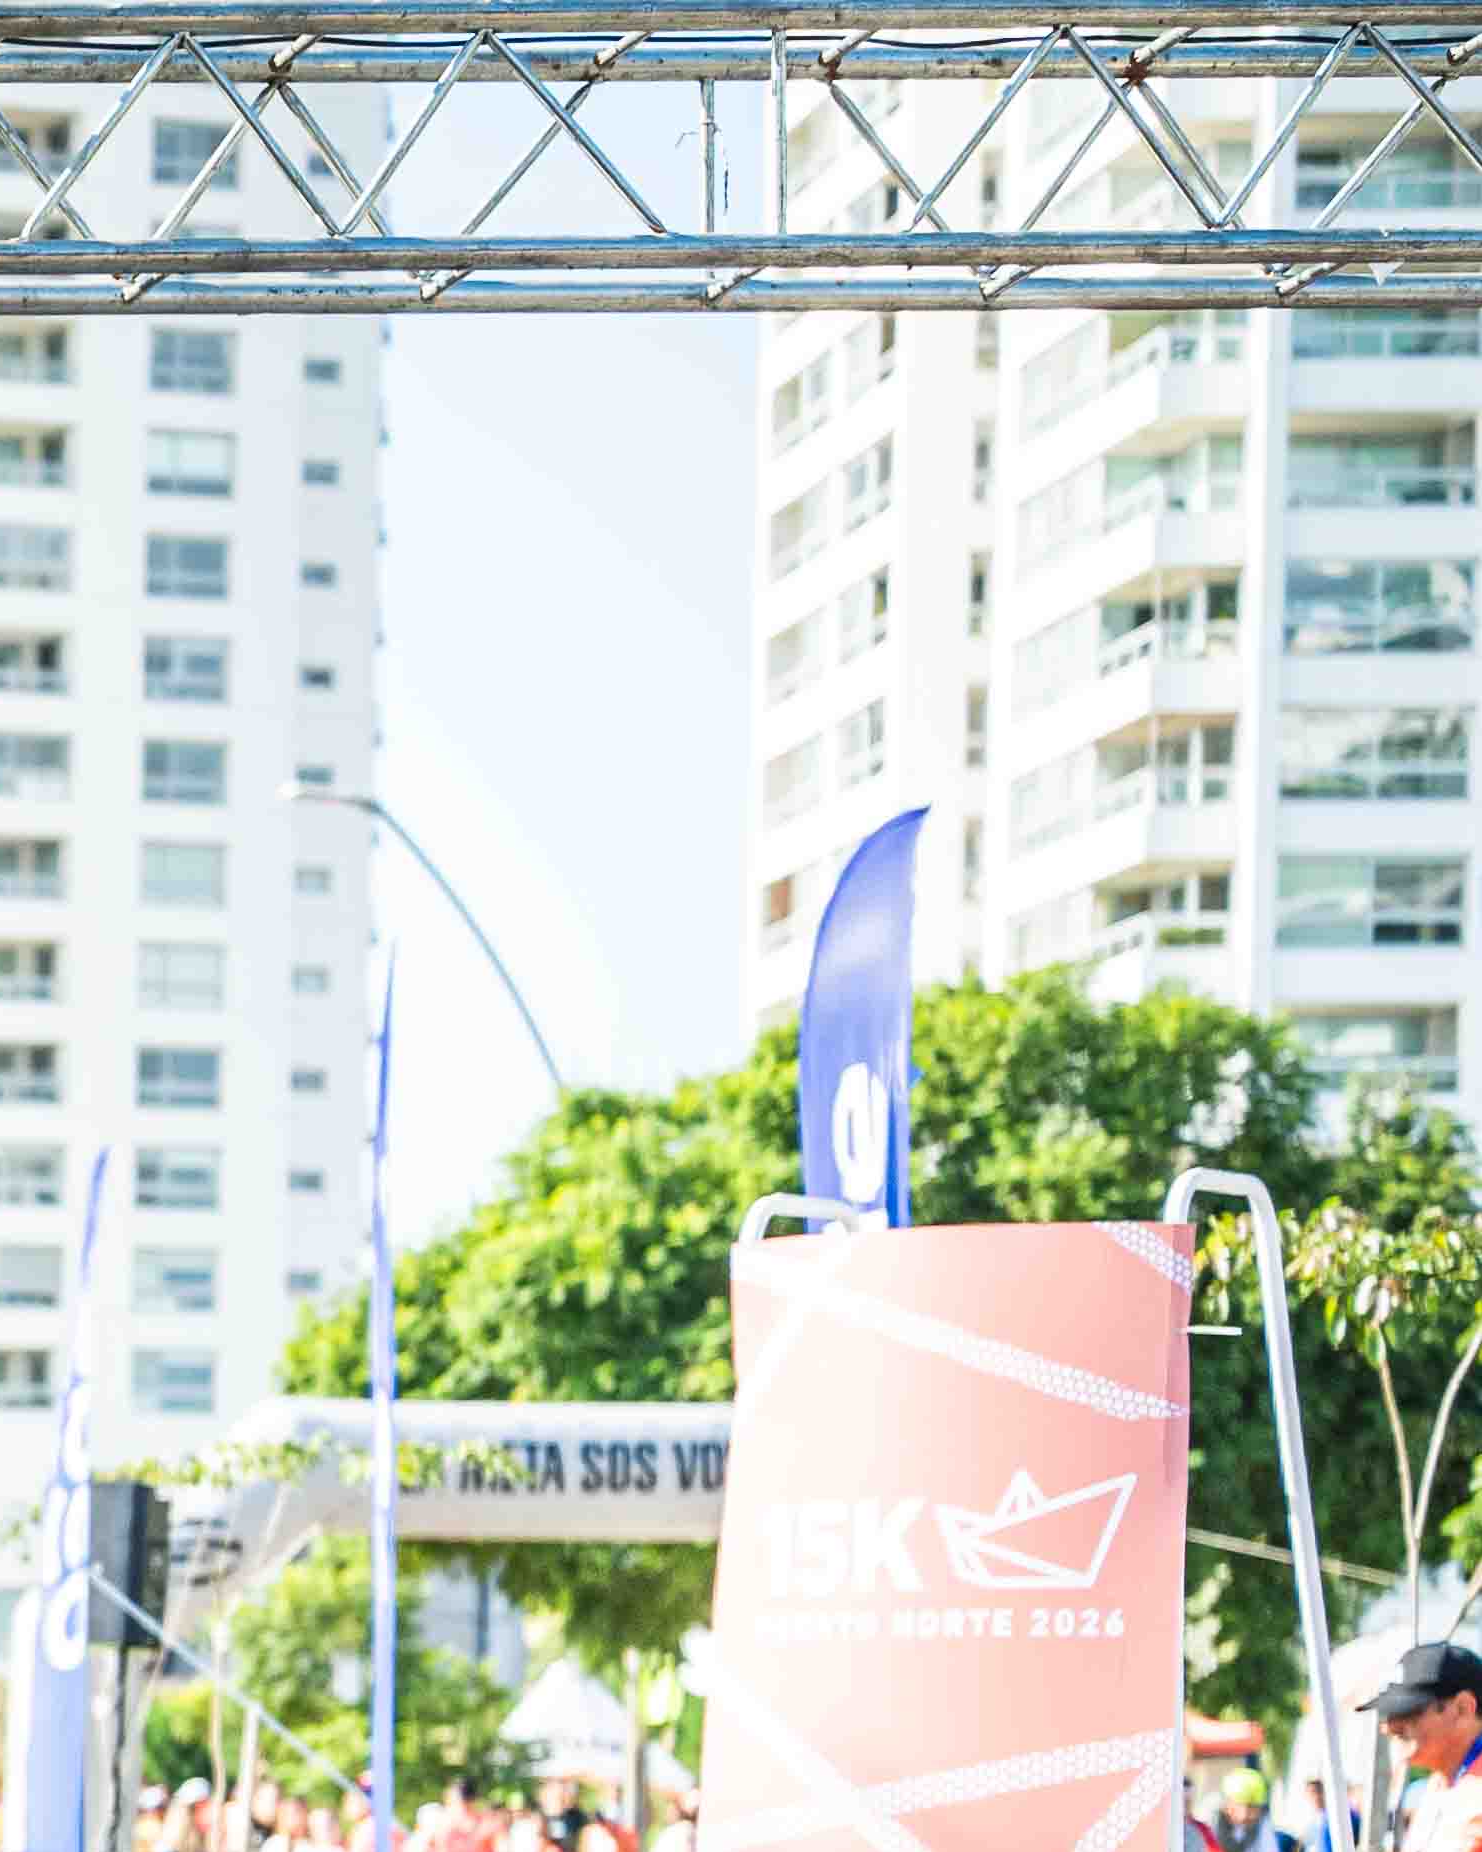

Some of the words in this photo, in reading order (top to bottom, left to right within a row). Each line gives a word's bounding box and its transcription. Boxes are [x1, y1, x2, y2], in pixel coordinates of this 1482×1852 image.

[580, 1439, 659, 1494] SOS
[758, 1498, 927, 1600] 15K
[890, 1607, 1014, 1638] NORTE
[1027, 1607, 1126, 1638] 2026
